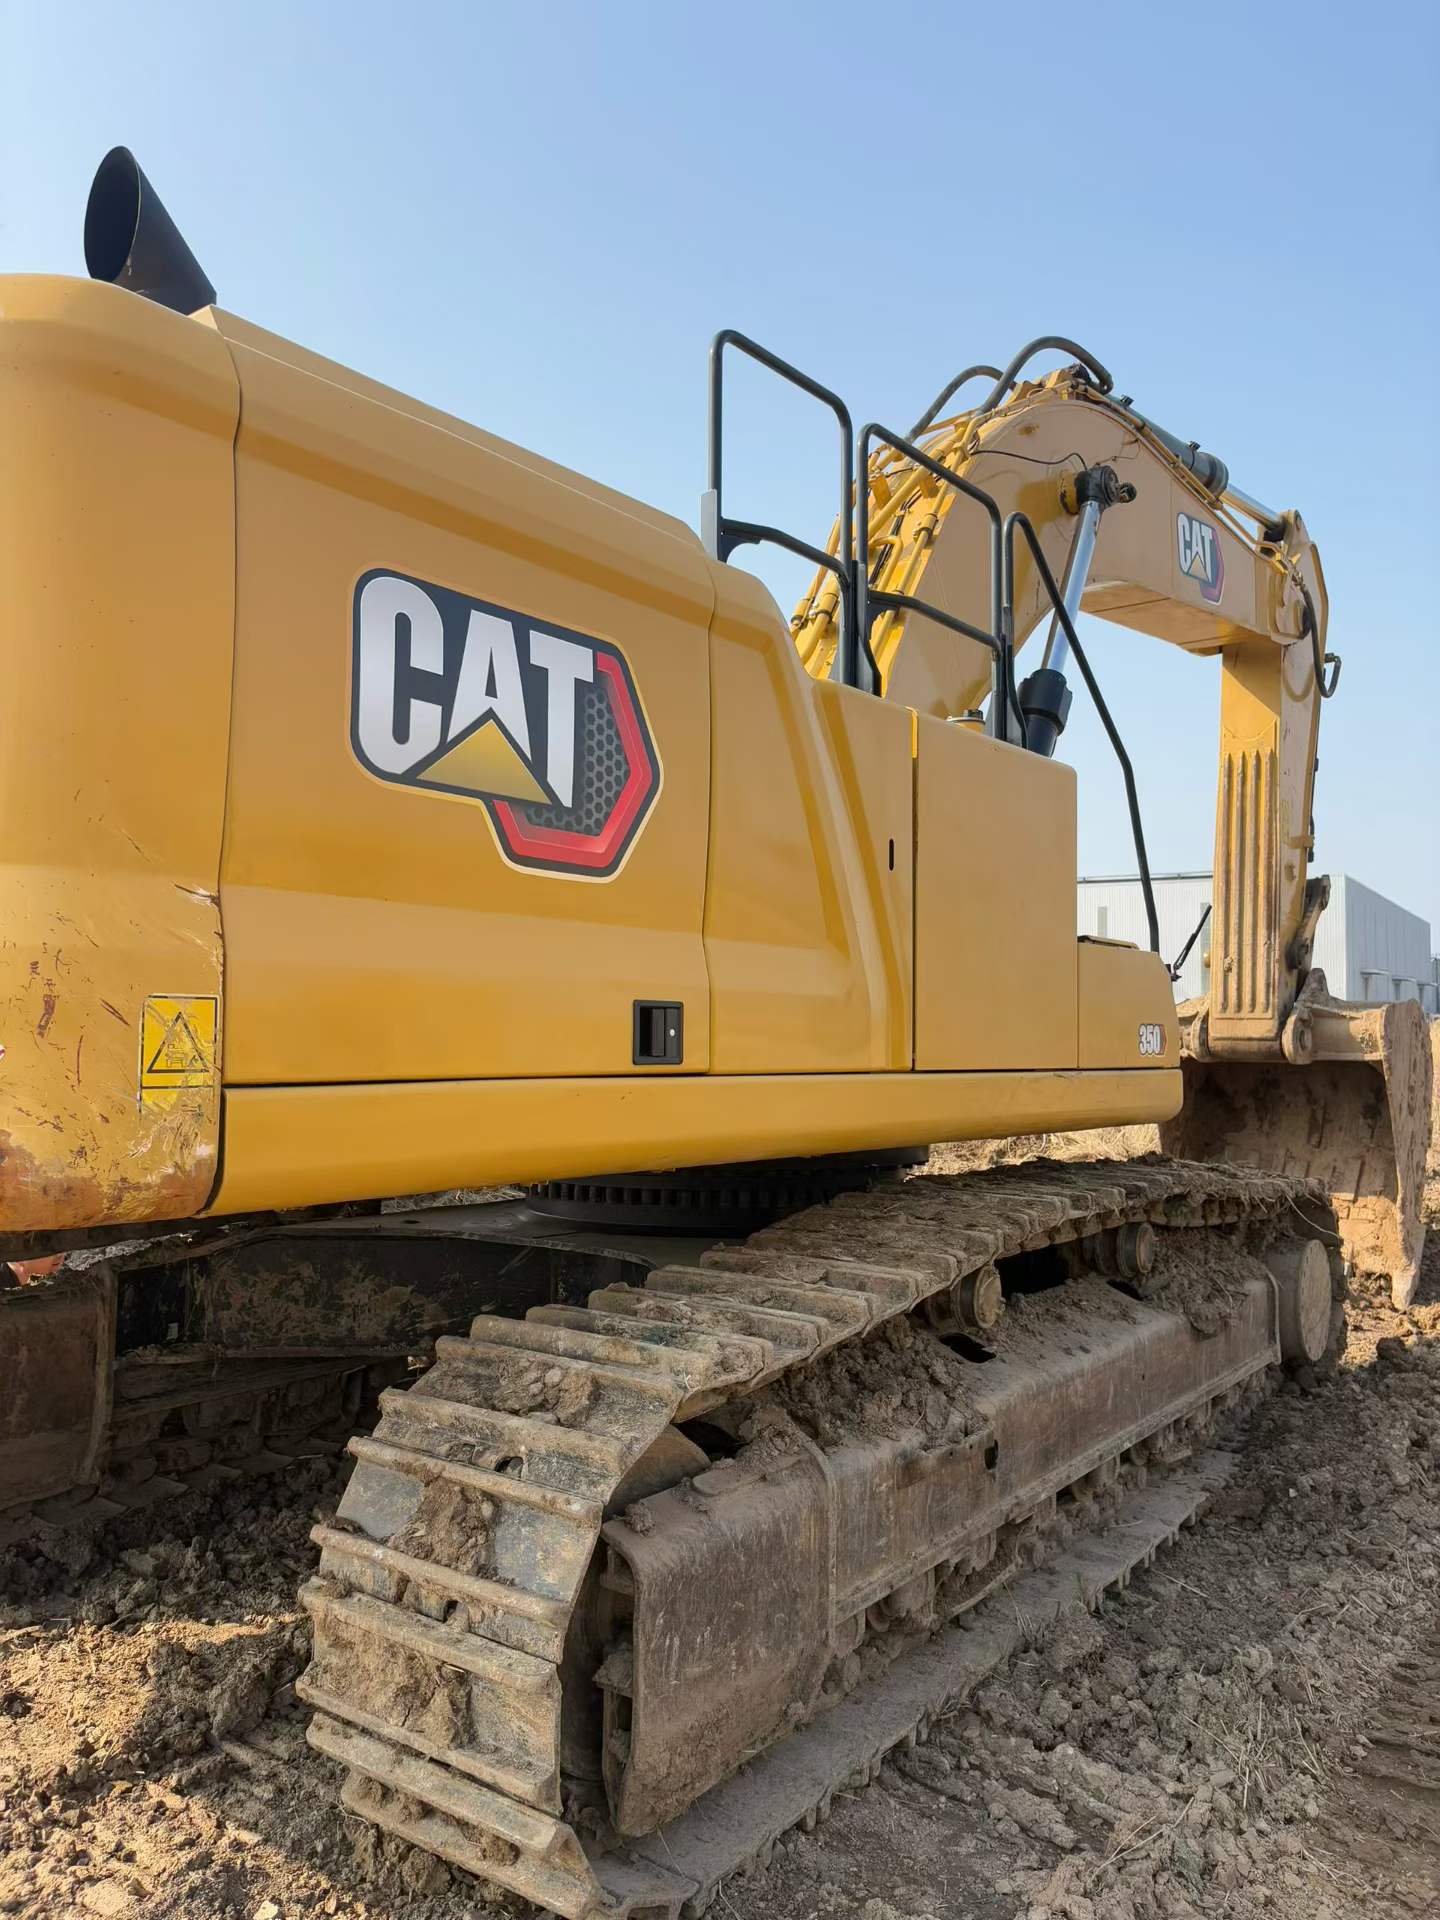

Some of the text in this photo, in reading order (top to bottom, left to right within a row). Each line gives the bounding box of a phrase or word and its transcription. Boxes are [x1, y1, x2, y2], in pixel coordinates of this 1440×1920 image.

[1178, 513, 1213, 583] CAT
[358, 576, 593, 808] CAT
[1139, 1024, 1161, 1054] 350
